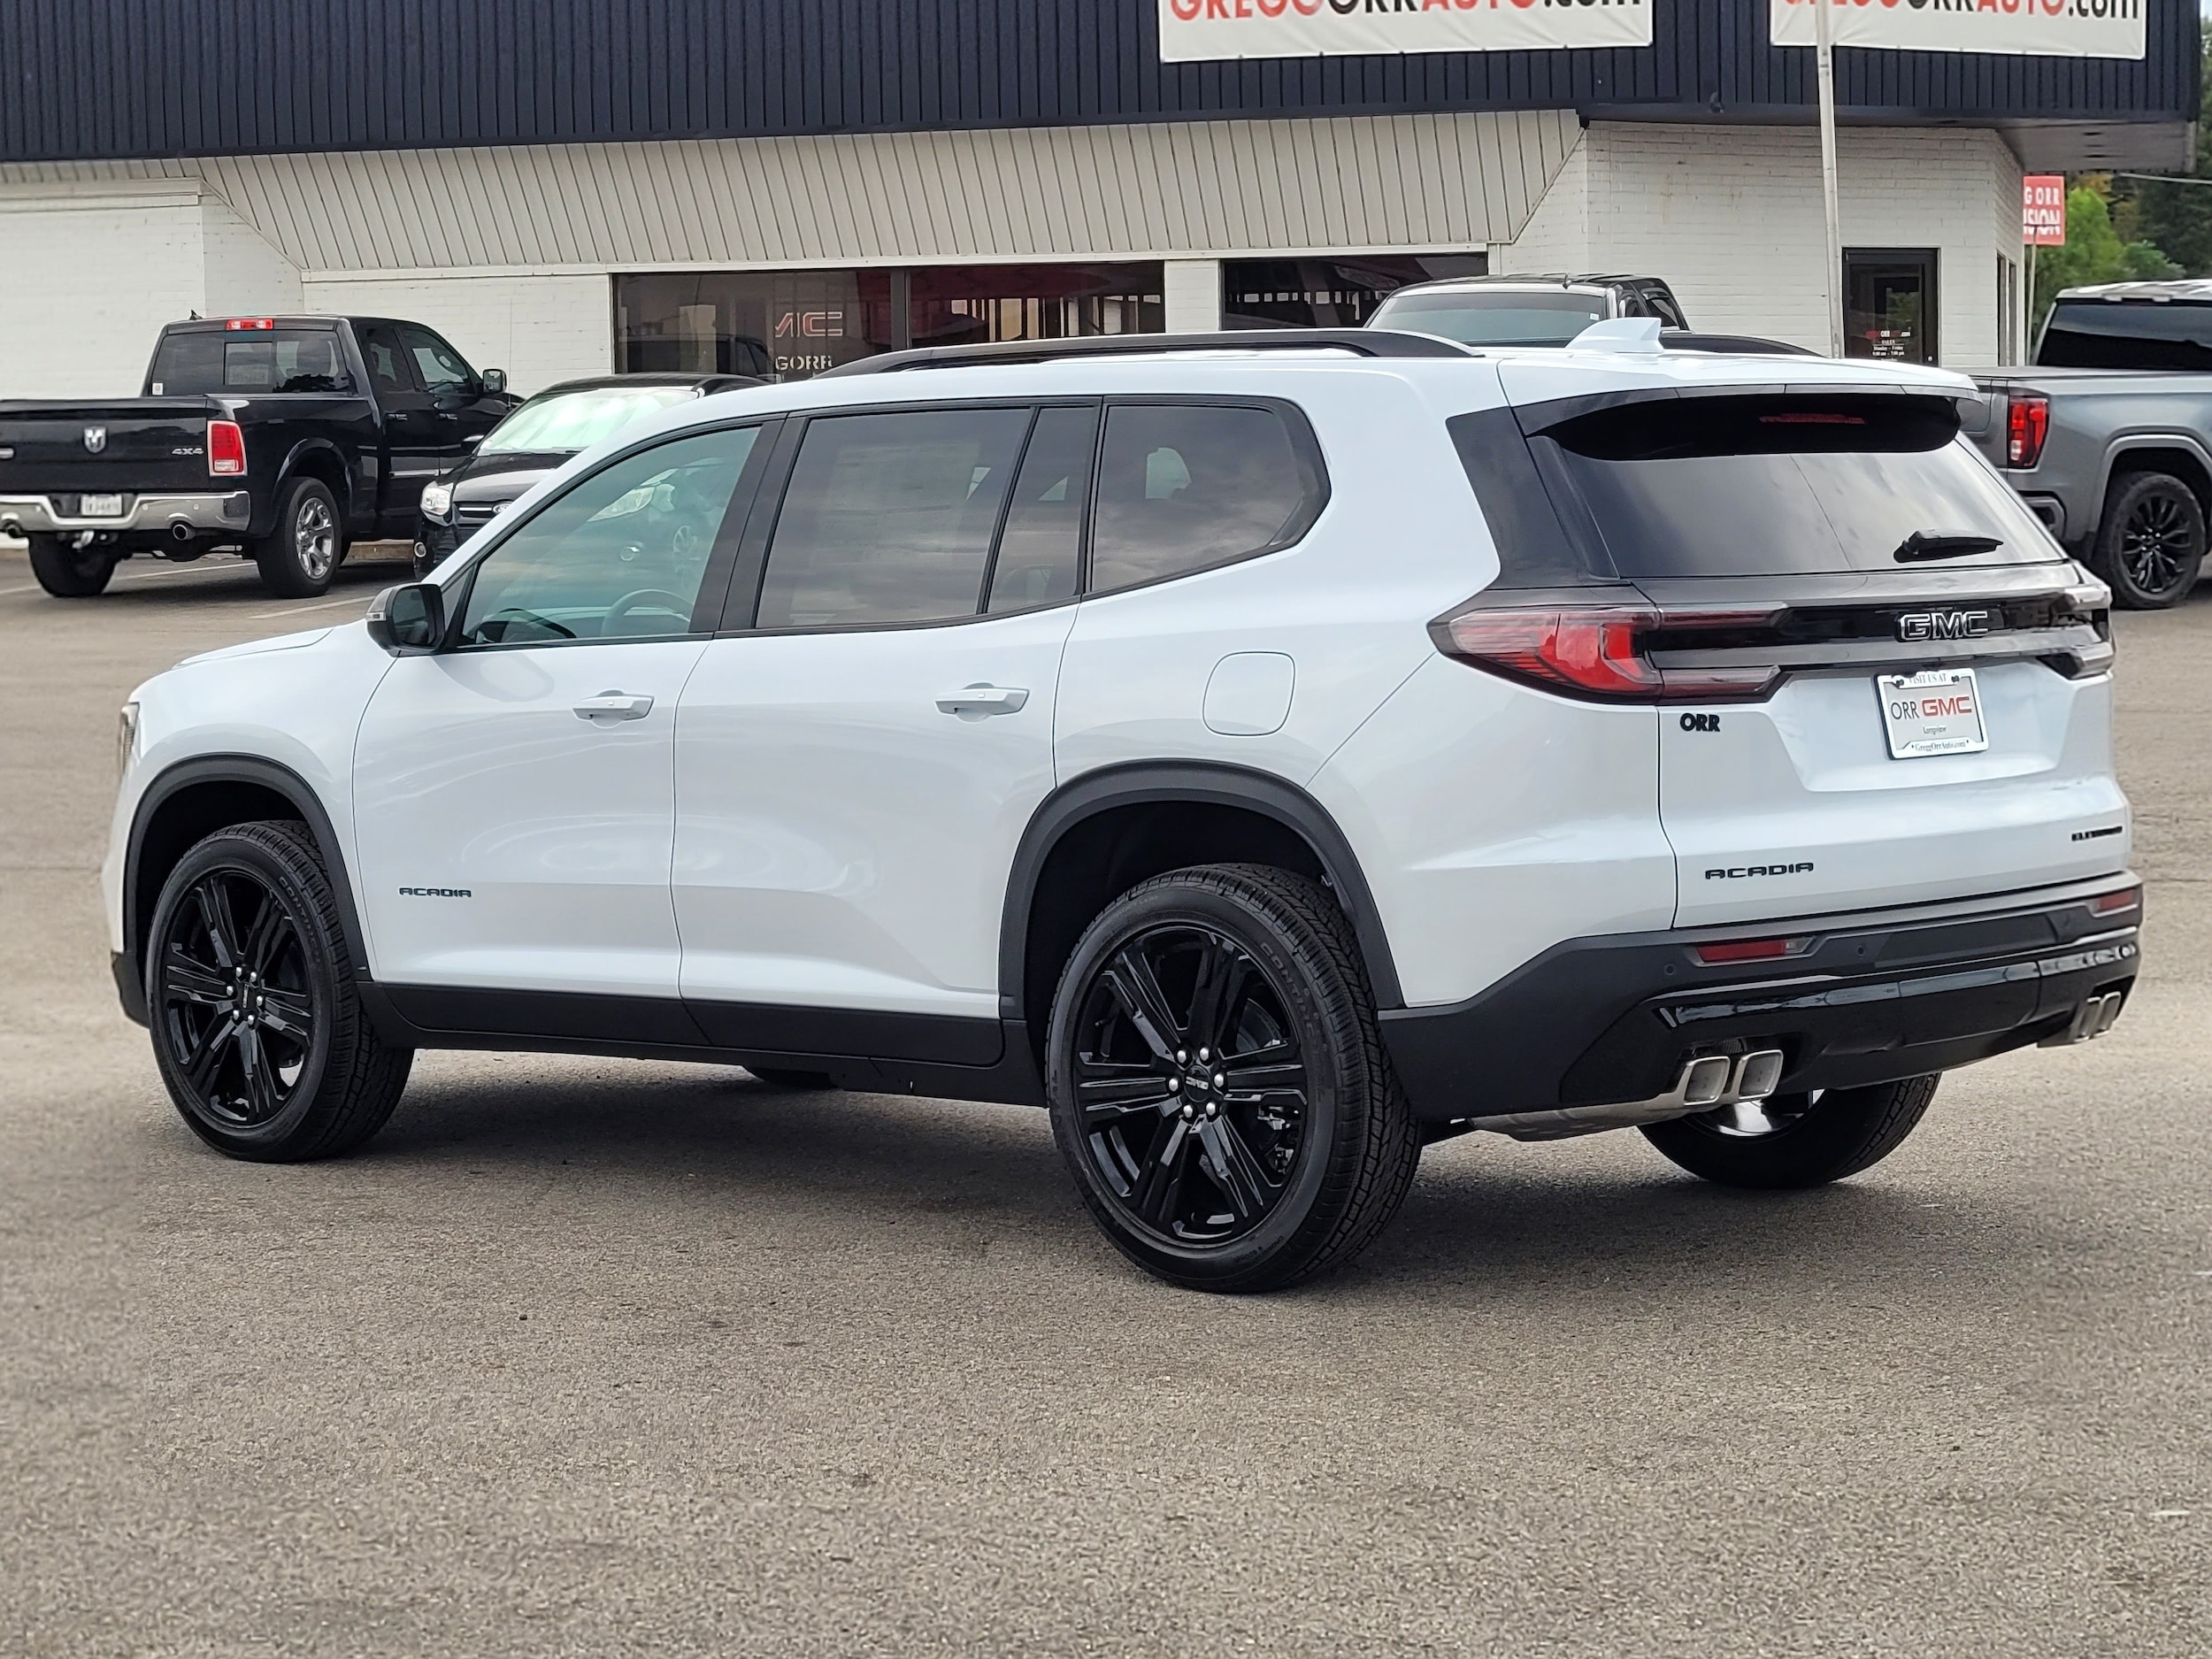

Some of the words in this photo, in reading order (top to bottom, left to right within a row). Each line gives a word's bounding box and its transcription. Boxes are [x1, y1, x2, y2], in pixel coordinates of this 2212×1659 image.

[2036, 187, 2060, 205] ORR
[1898, 611, 1989, 641] GMC
[1891, 701, 1920, 719] ORR
[1922, 696, 1972, 717] GMC
[1679, 712, 1721, 732] ORR
[1705, 863, 1814, 879] ACADIA
[399, 887, 472, 898] ACADIA
[1260, 941, 1326, 1102] CONTINEAL
